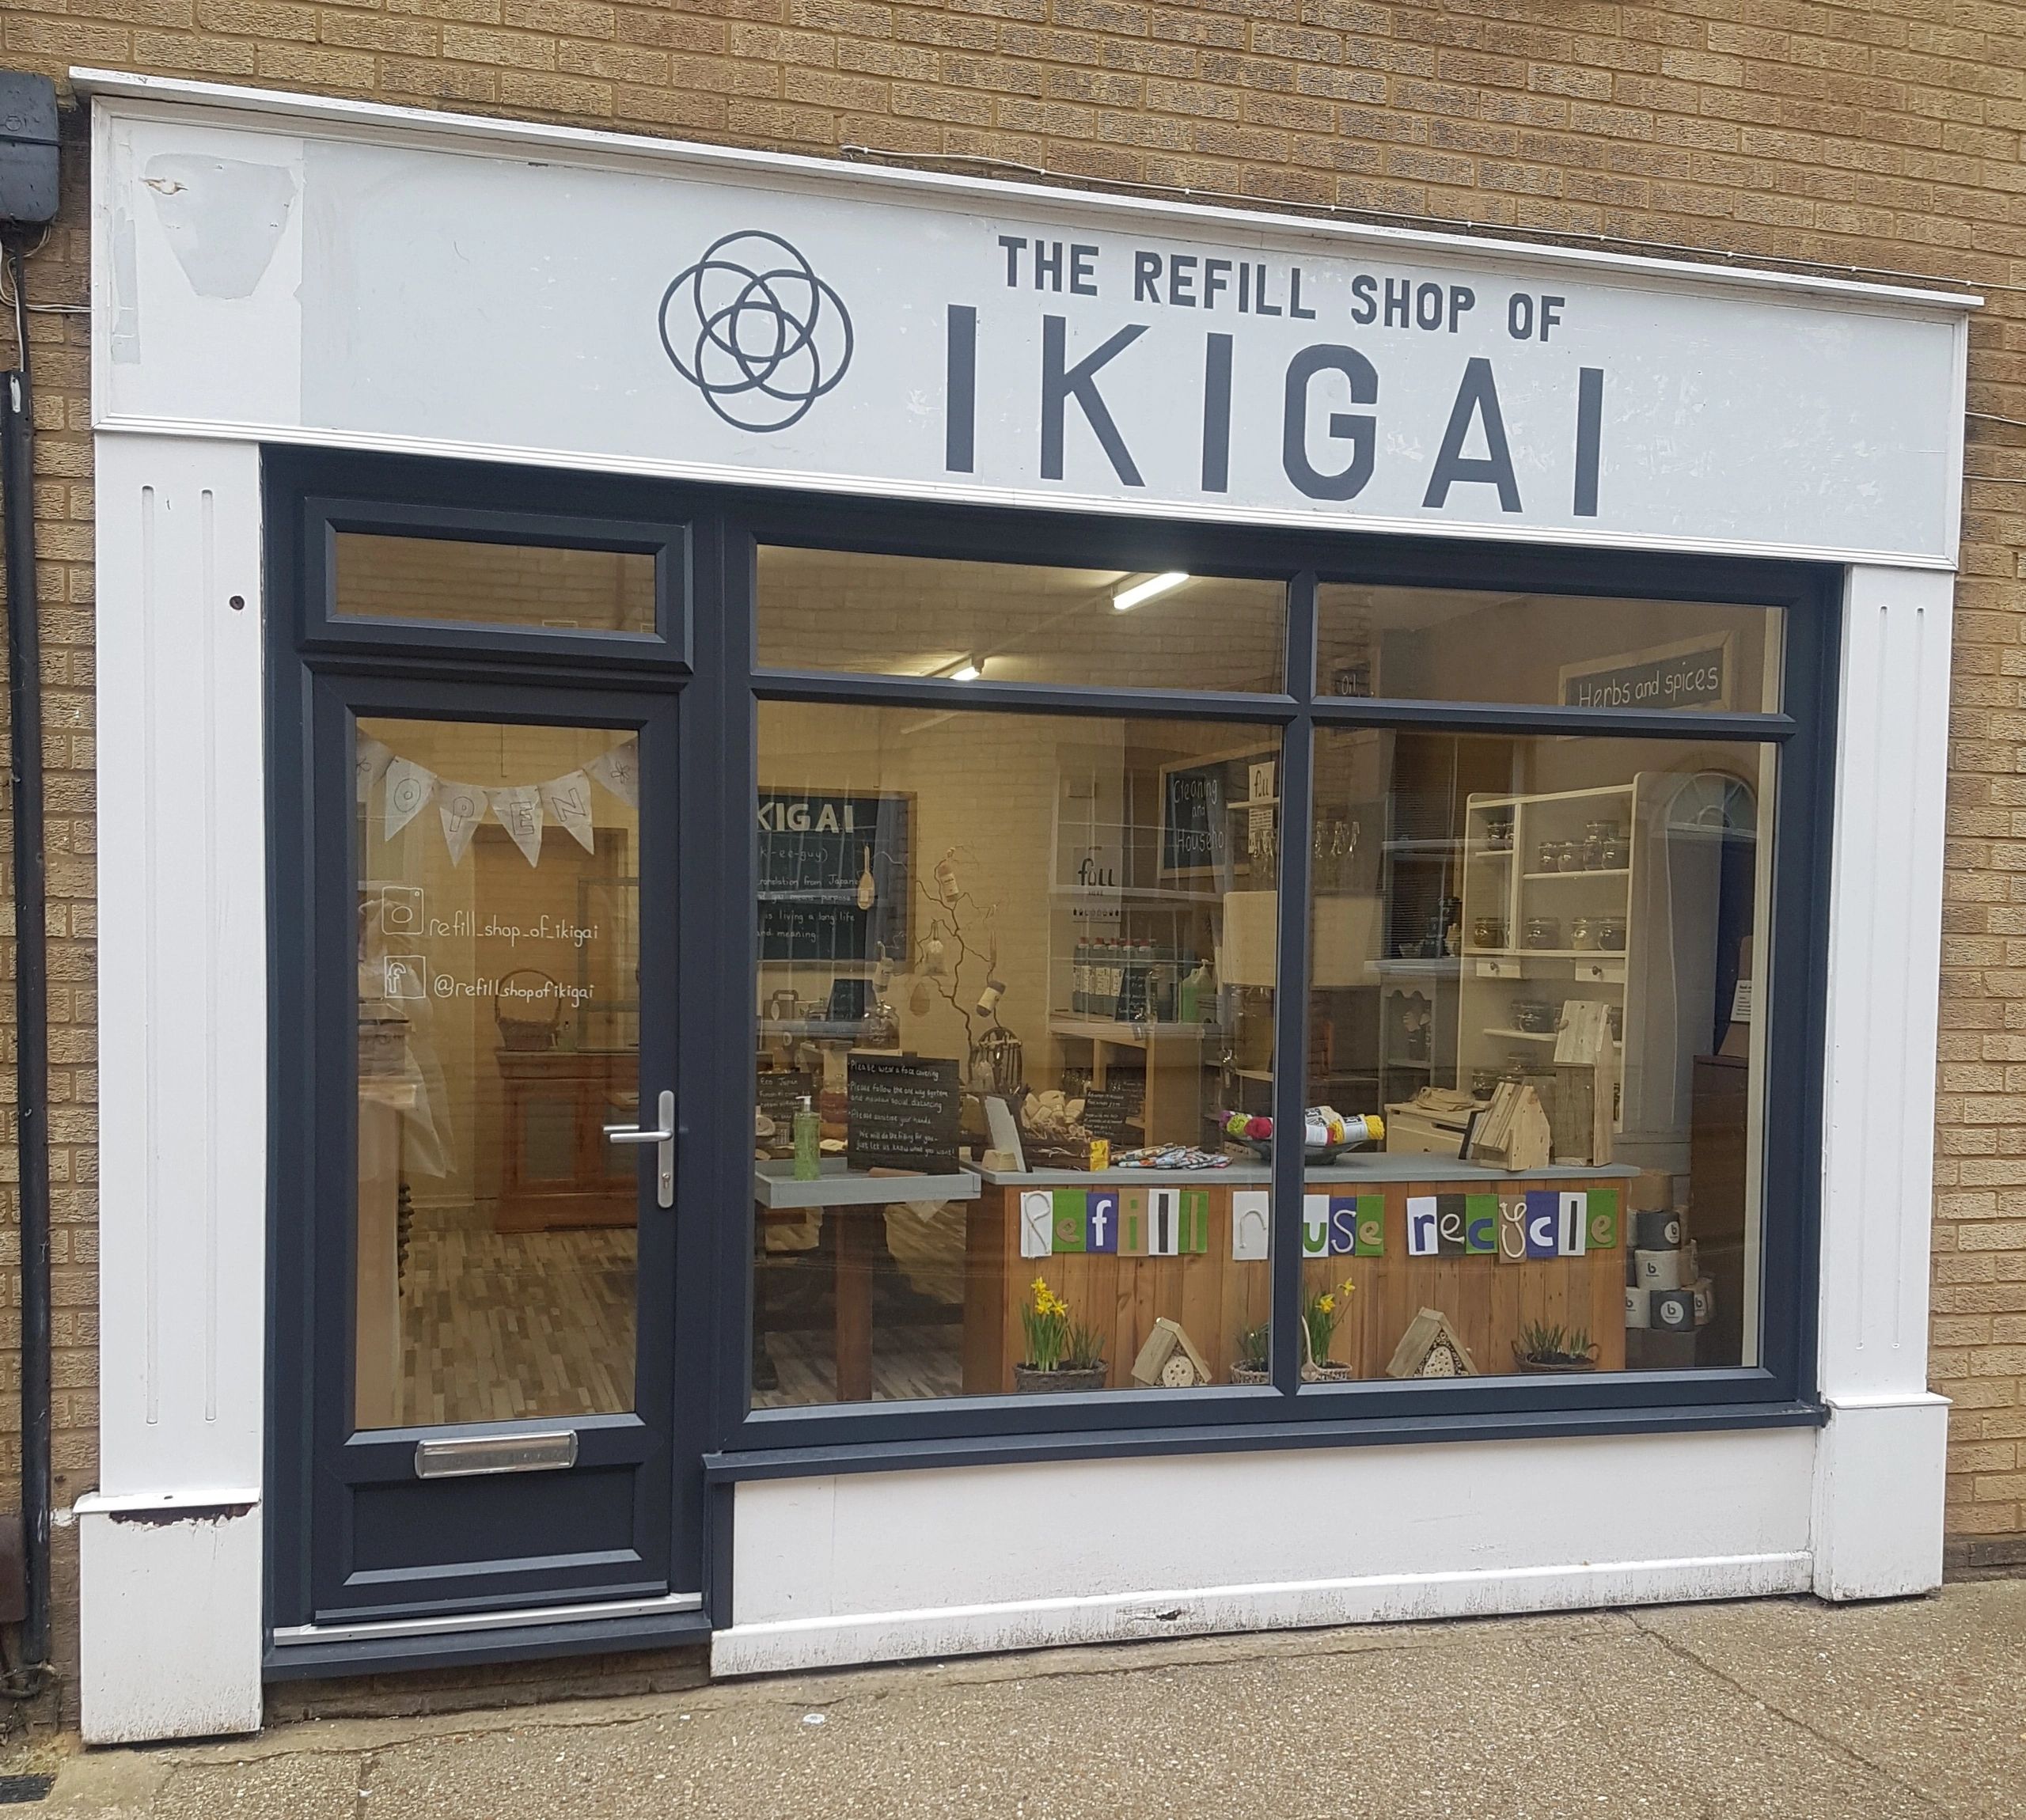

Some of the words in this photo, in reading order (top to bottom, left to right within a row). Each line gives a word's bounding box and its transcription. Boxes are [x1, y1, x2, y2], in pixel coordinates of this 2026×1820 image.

[998, 235, 1099, 296] THE
[1134, 251, 1315, 320] REFILL
[1351, 274, 1476, 333] SHOP
[1508, 293, 1566, 342] OF
[945, 304, 1604, 518] IKIGAI
[1580, 678, 1631, 707] Herbs
[1635, 670, 1660, 700] and
[1665, 667, 1719, 701] spices
[1174, 779, 1218, 805] Cleaning
[393, 778, 588, 836] OPEN
[429, 910, 598, 947] refill_shop_of_ikigai
[780, 910, 804, 923] living
[818, 911, 836, 925] long
[840, 911, 856, 922] life
[777, 927, 817, 943] meaning
[851, 1060, 876, 1072] Please
[901, 1065, 915, 1075] face
[916, 1069, 939, 1082] covering
[850, 1081, 871, 1092] Please
[872, 1083, 892, 1094] follow
[914, 1089, 926, 1098] way
[851, 1109, 872, 1120] Please
[892, 1143, 909, 1152] know
[1024, 1192, 1200, 1259] Refill
[1413, 1199, 1613, 1259] recycle
